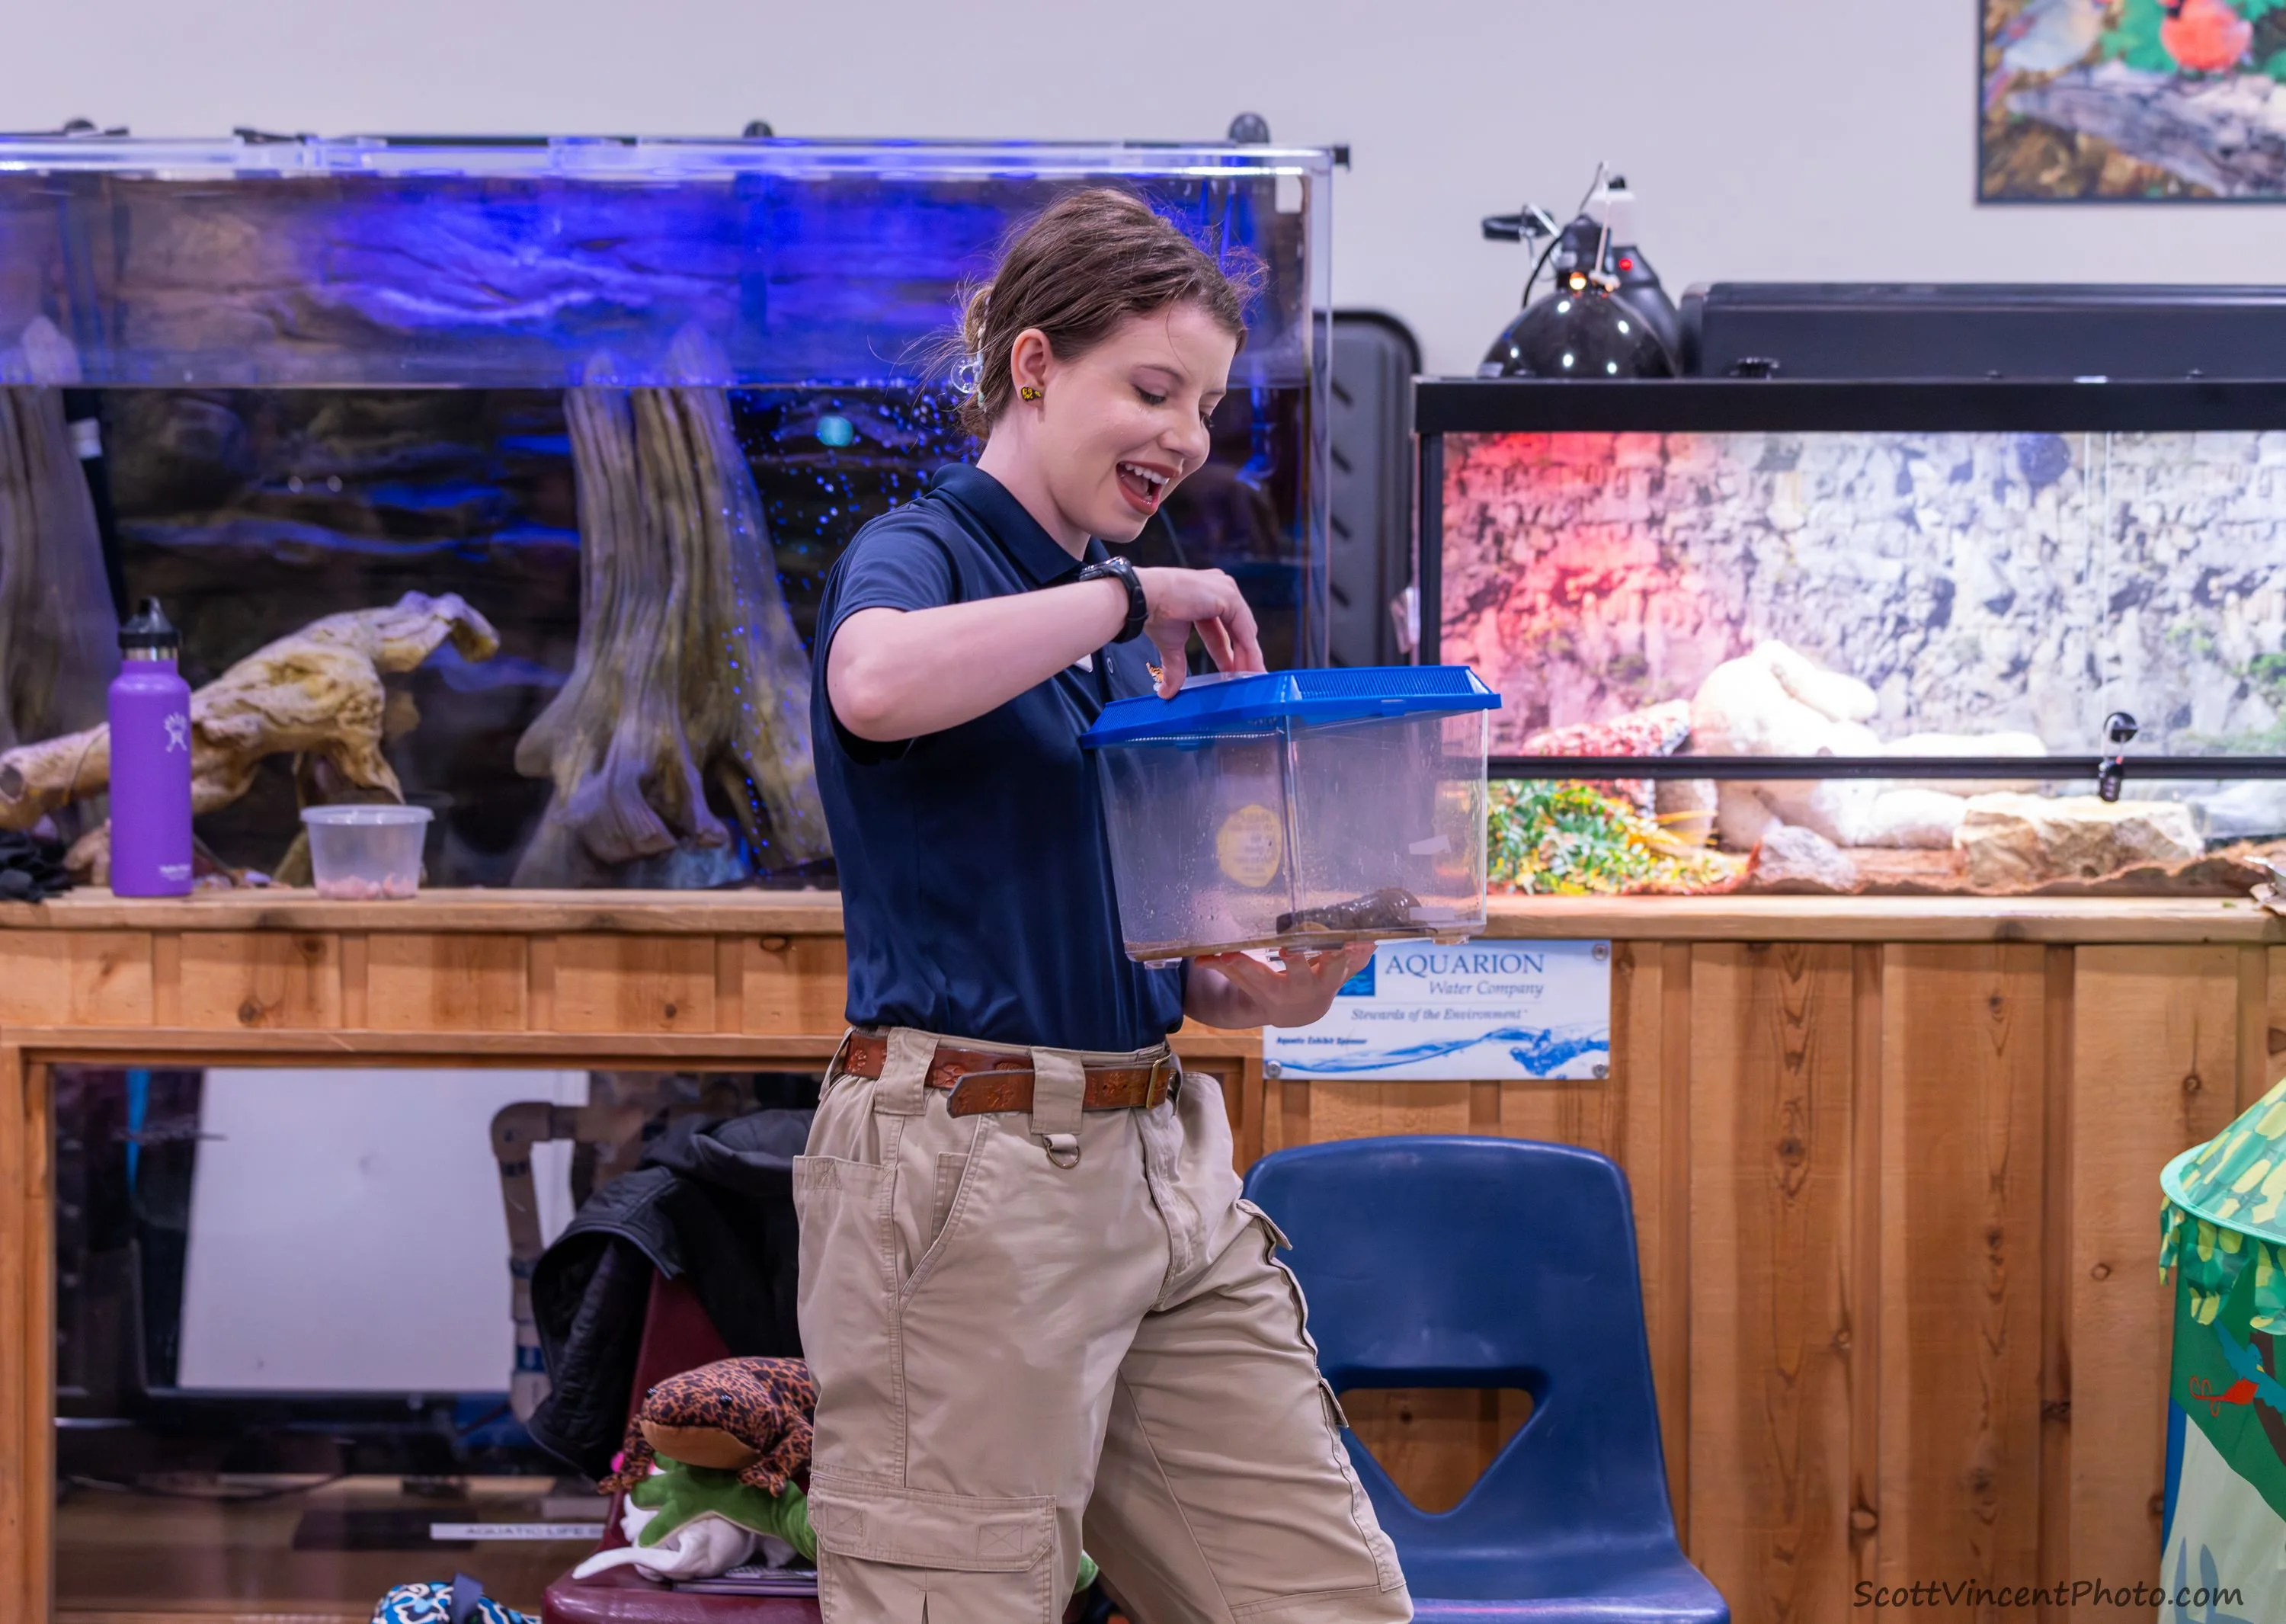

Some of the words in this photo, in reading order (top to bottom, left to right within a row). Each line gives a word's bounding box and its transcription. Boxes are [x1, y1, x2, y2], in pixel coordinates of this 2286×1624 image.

[1385, 954, 1544, 978] AQUARION
[1430, 981, 1472, 995] Water
[1477, 980, 1545, 998] Company
[1351, 1008, 1405, 1020] Stewards
[1408, 1008, 1422, 1022] of
[1423, 1009, 1441, 1020] the
